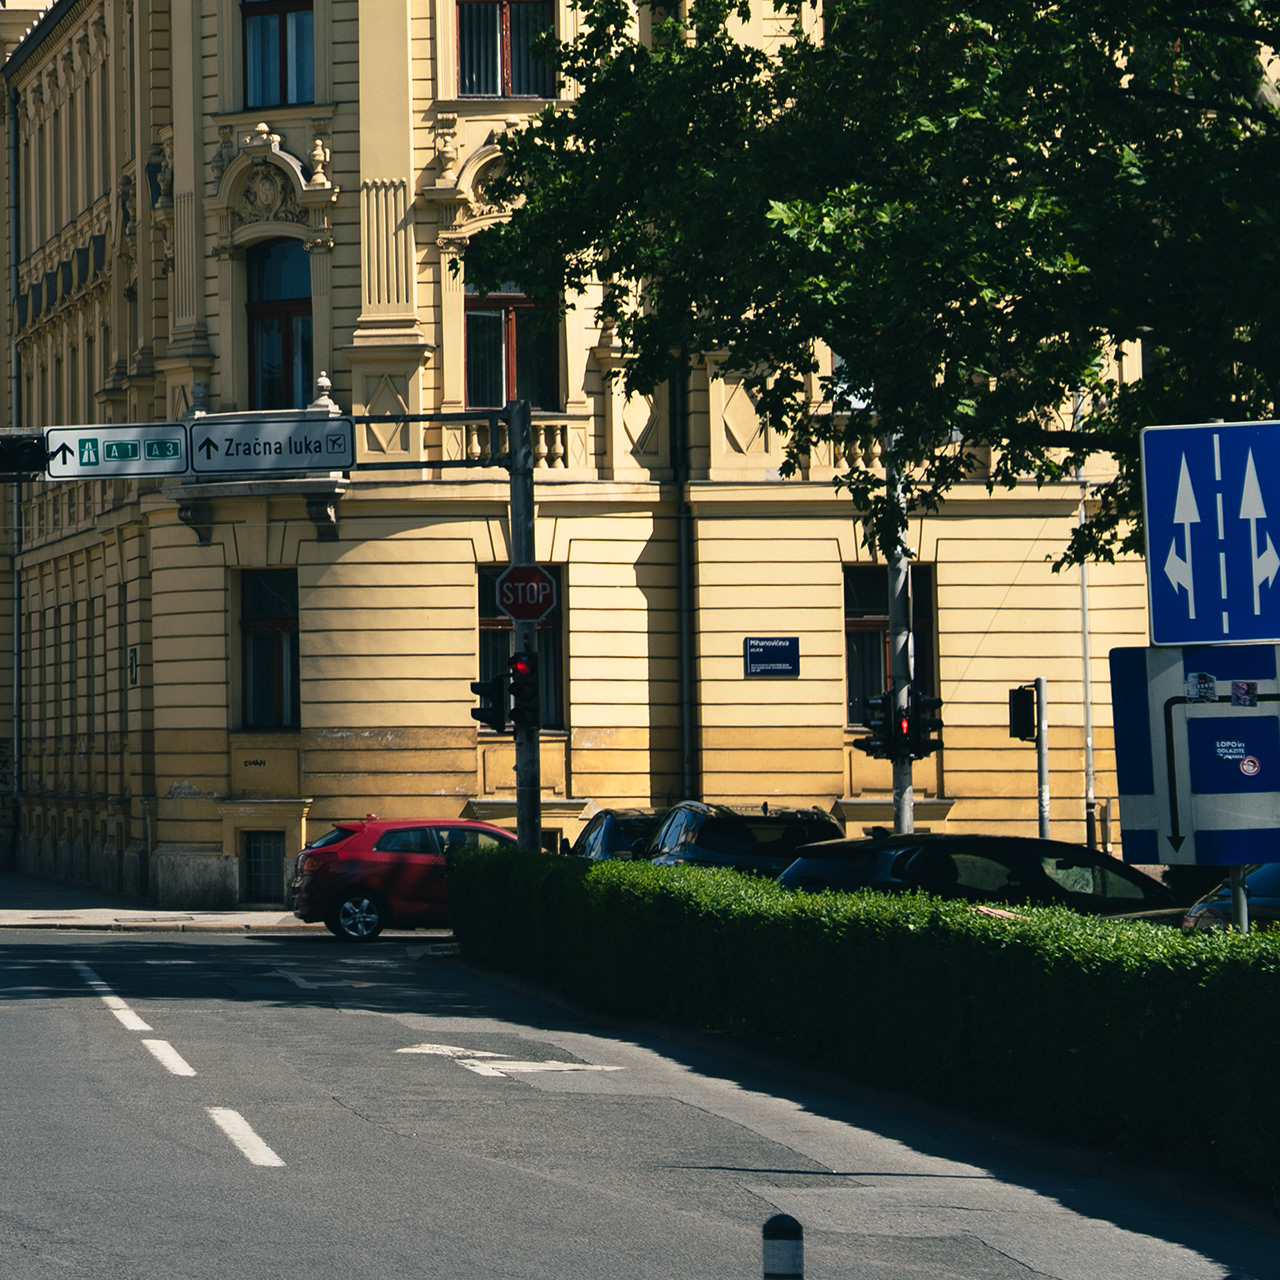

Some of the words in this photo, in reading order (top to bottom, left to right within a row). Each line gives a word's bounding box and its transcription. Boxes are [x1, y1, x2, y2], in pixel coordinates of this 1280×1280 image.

[224, 437, 283, 457] Zračna
[289, 435, 322, 455] luka
[502, 582, 550, 604] STOP
